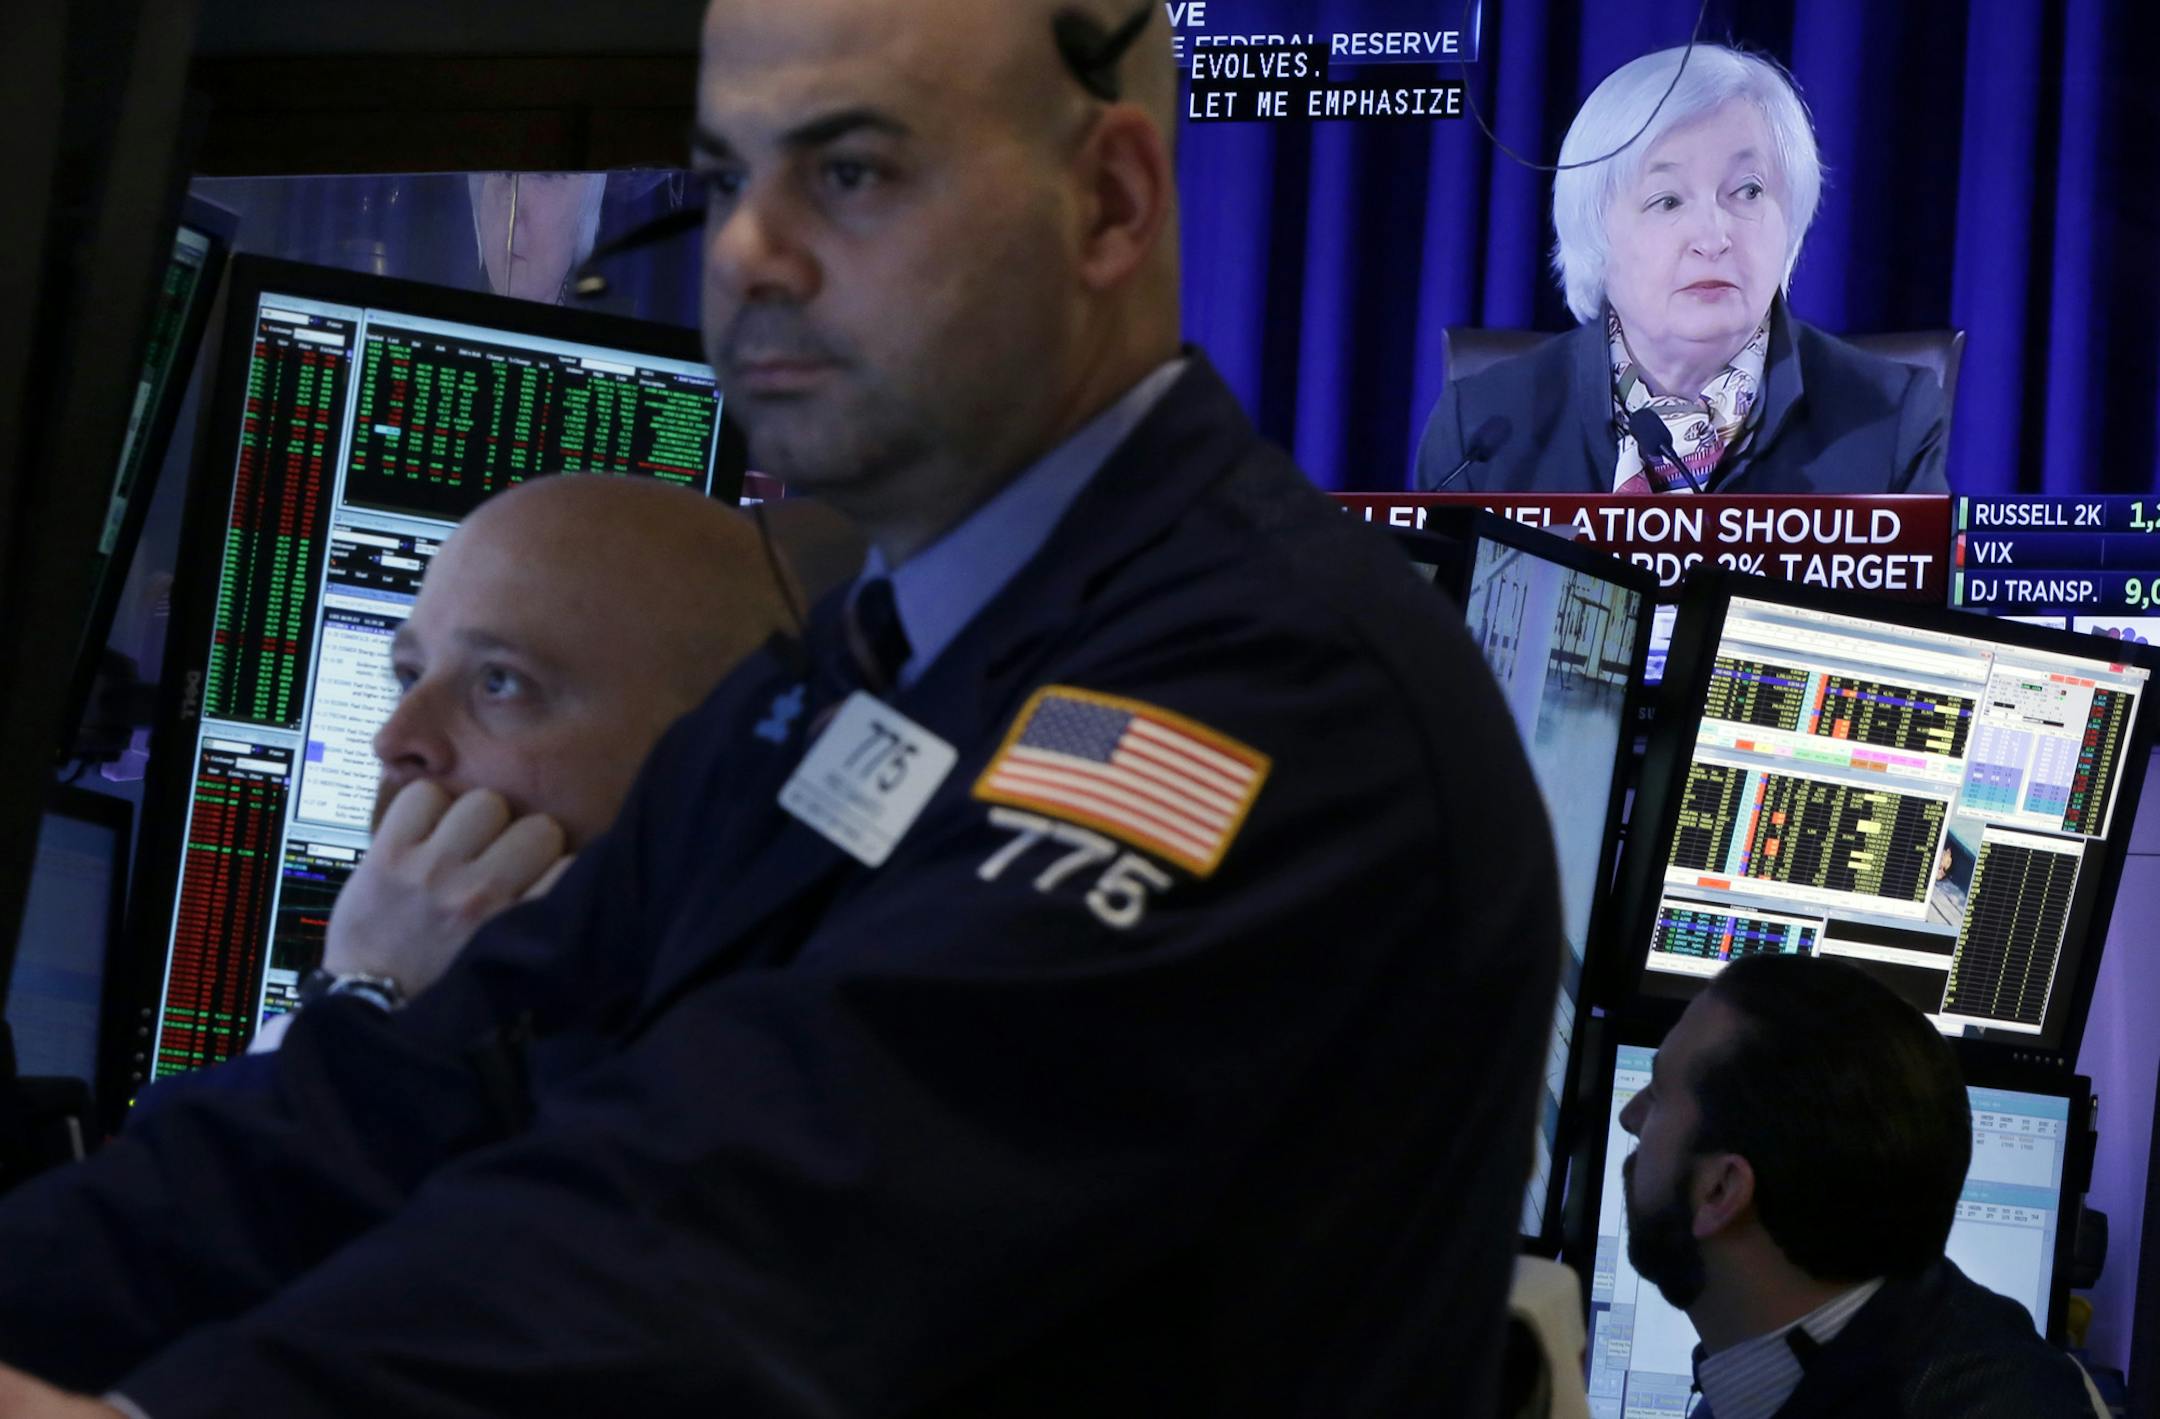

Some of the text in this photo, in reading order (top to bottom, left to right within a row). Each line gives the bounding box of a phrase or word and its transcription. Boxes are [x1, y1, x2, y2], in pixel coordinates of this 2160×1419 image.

[1165, 2, 1206, 27] VE
[1331, 31, 1459, 55] RESERVE
[1192, 52, 1320, 79] EVOLVES.
[1189, 88, 1461, 118] LET ME EMPHASIZE
[1717, 508, 1901, 543] SHOULD
[1975, 504, 2068, 525] RUSSELL
[2073, 504, 2102, 525] 2K
[1973, 541, 2014, 563] VIX
[1779, 553, 1933, 590] TARGET
[1971, 579, 1998, 602] DJ
[2004, 580, 2098, 603] TRANSP.
[977, 807, 1174, 929] 775
